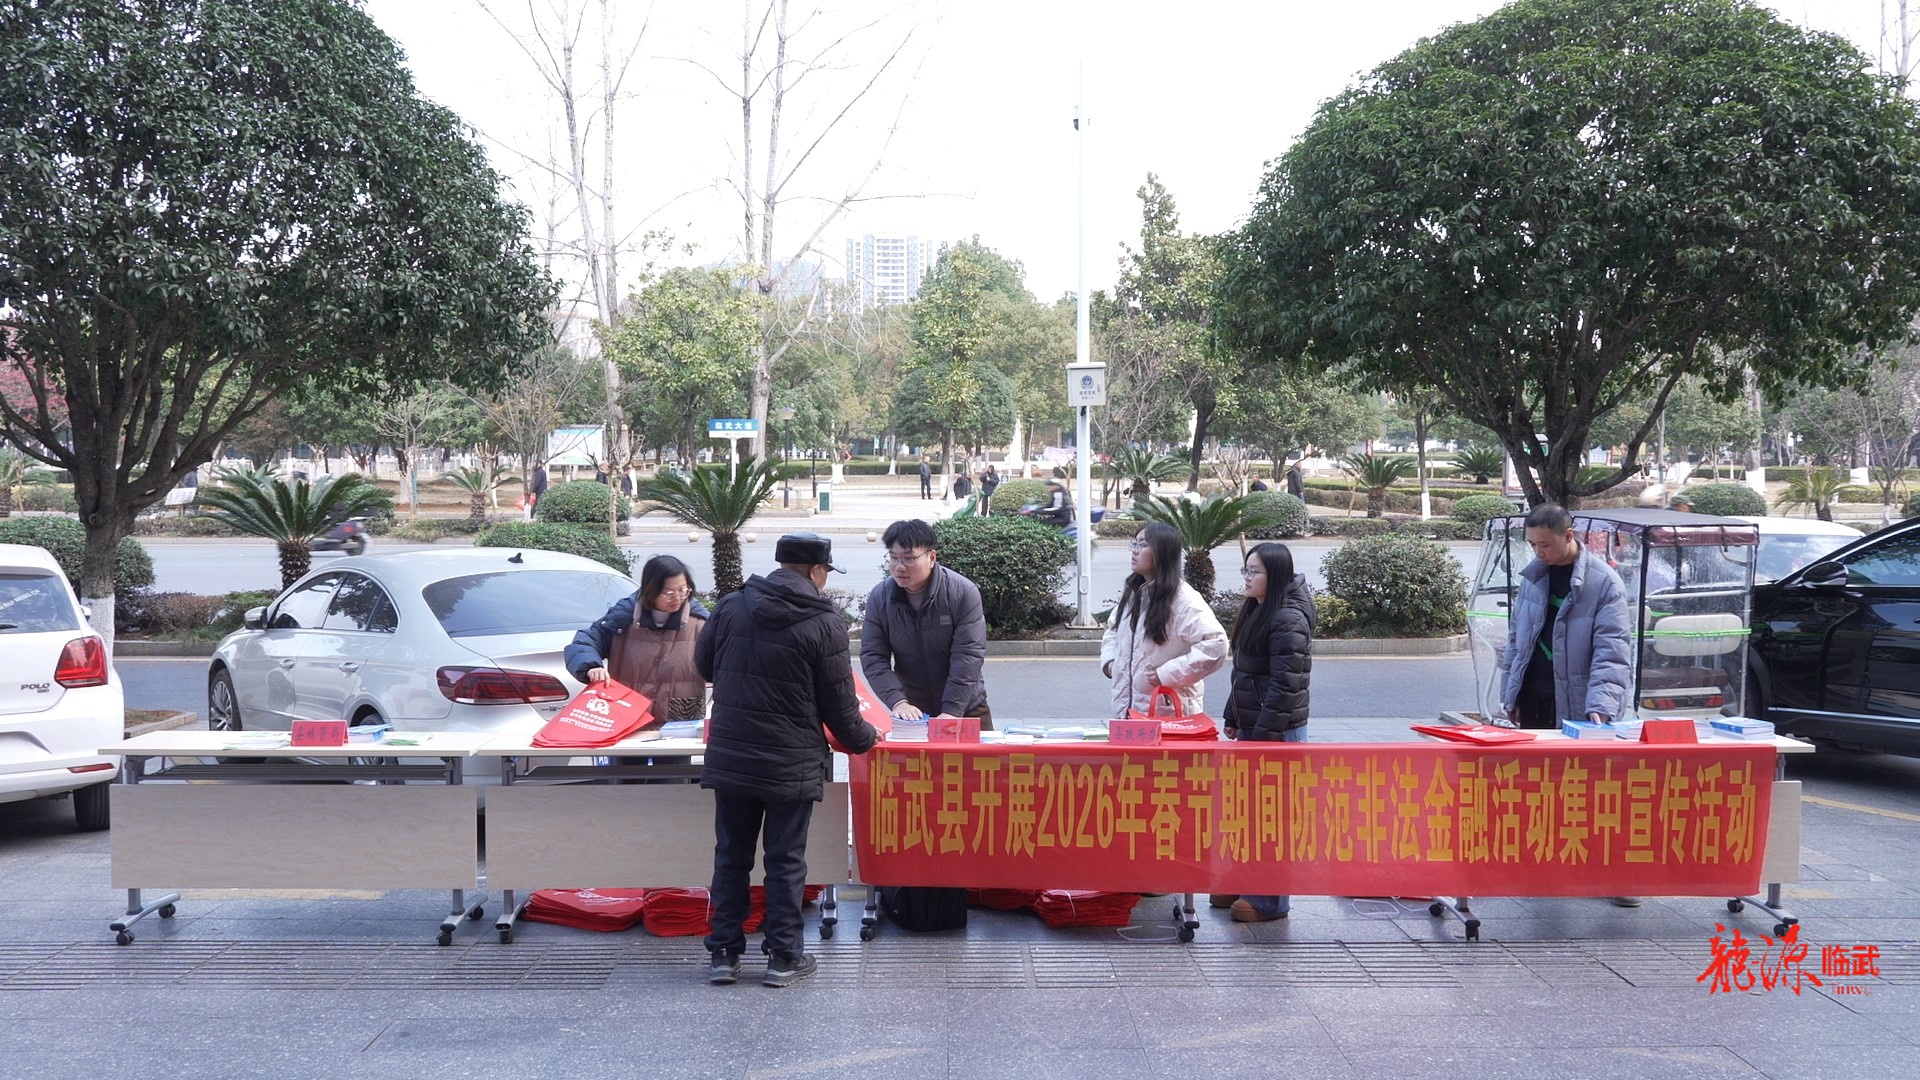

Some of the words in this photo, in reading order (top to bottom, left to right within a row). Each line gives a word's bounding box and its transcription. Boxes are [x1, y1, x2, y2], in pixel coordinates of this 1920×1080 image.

[20, 682, 50, 691] POLO
[868, 749, 1757, 865] 临武县开展2026年春节期间防范非法金融活动集中宣传活动
